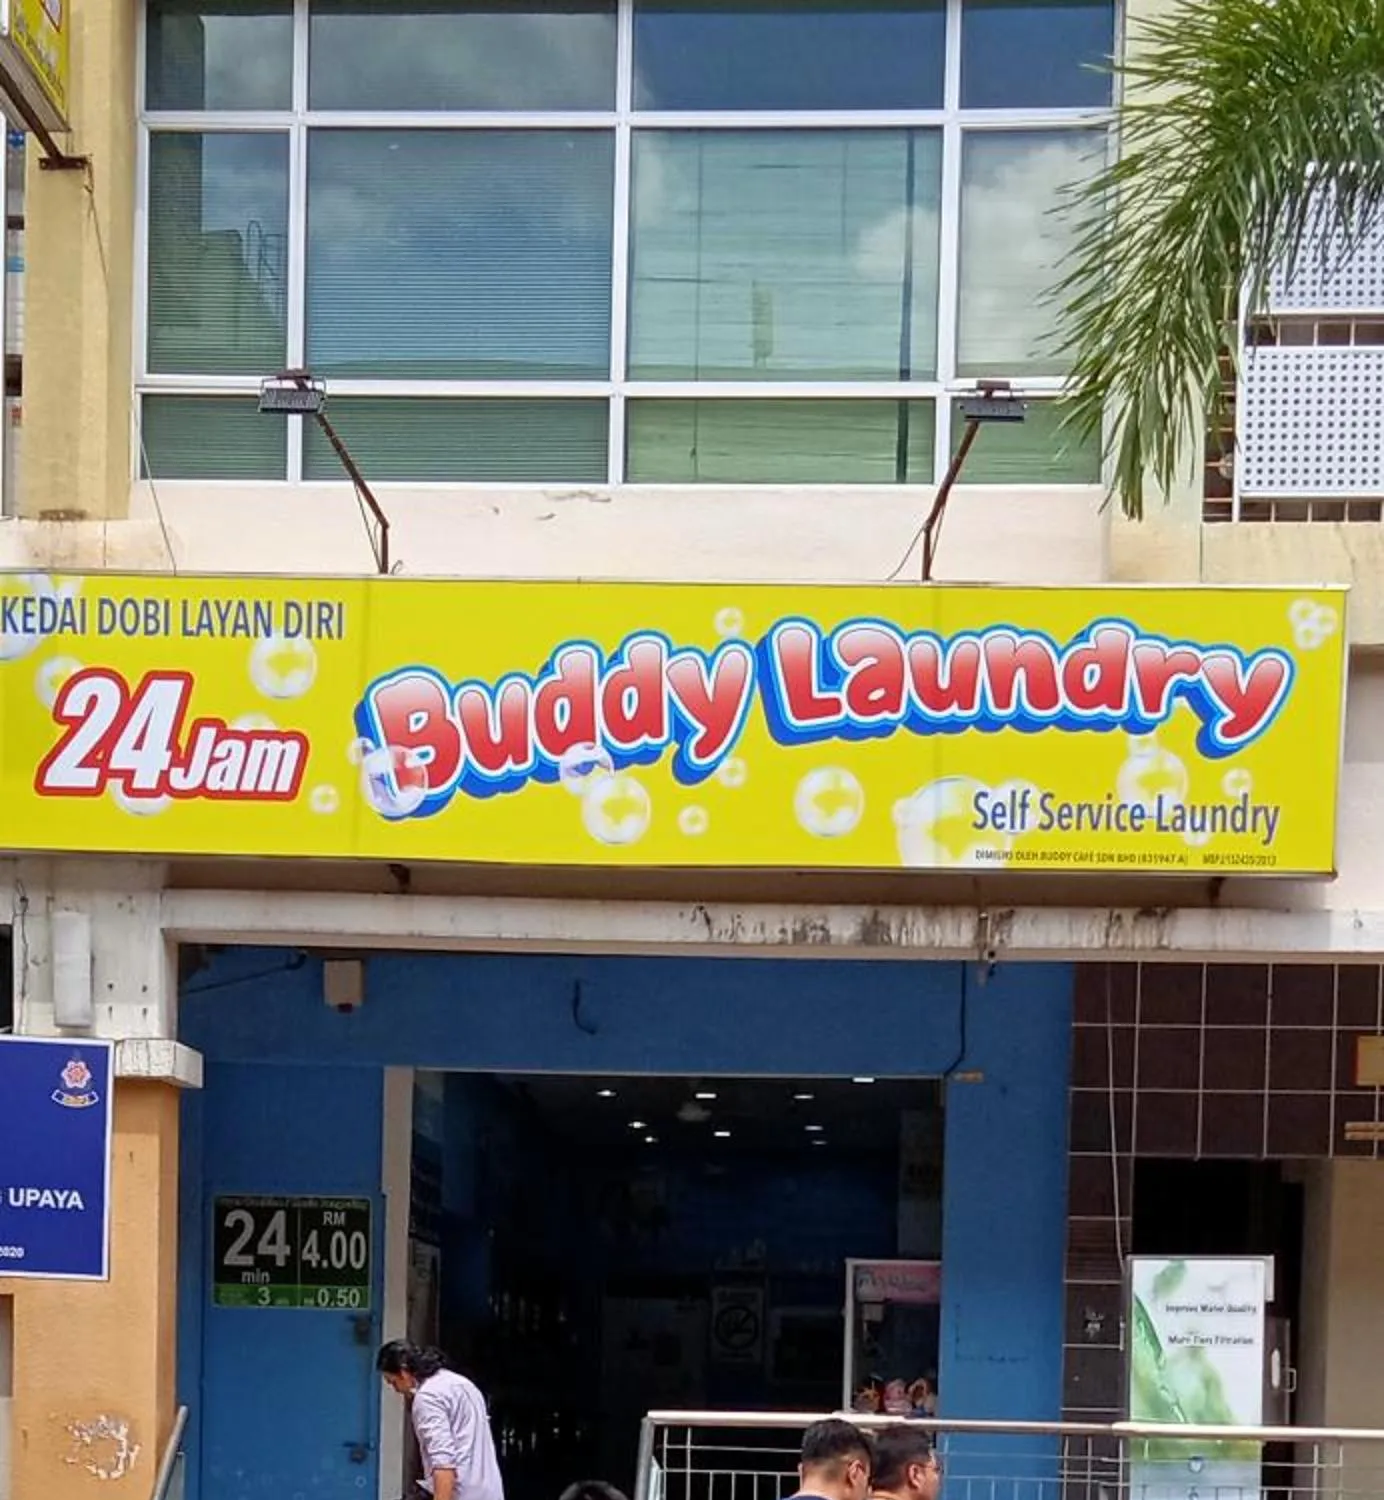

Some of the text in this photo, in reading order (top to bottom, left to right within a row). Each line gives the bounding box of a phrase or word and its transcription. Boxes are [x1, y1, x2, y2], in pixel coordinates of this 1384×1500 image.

[1, 596, 345, 641] KEDAI DOBI LAYAN DIRI
[360, 621, 1289, 810] Buddy Laundry
[971, 789, 1281, 846] Self Service Laundry
[8, 1187, 84, 1210] UPAYA
[322, 1210, 347, 1226] RM
[223, 1209, 291, 1267] 24
[301, 1229, 367, 1270] 4.00
[241, 1268, 271, 1284] min
[257, 1286, 272, 1305] 3
[317, 1287, 361, 1308] 0.50
[1200, 1304, 1224, 1313] Water
[1227, 1304, 1257, 1315] Quality
